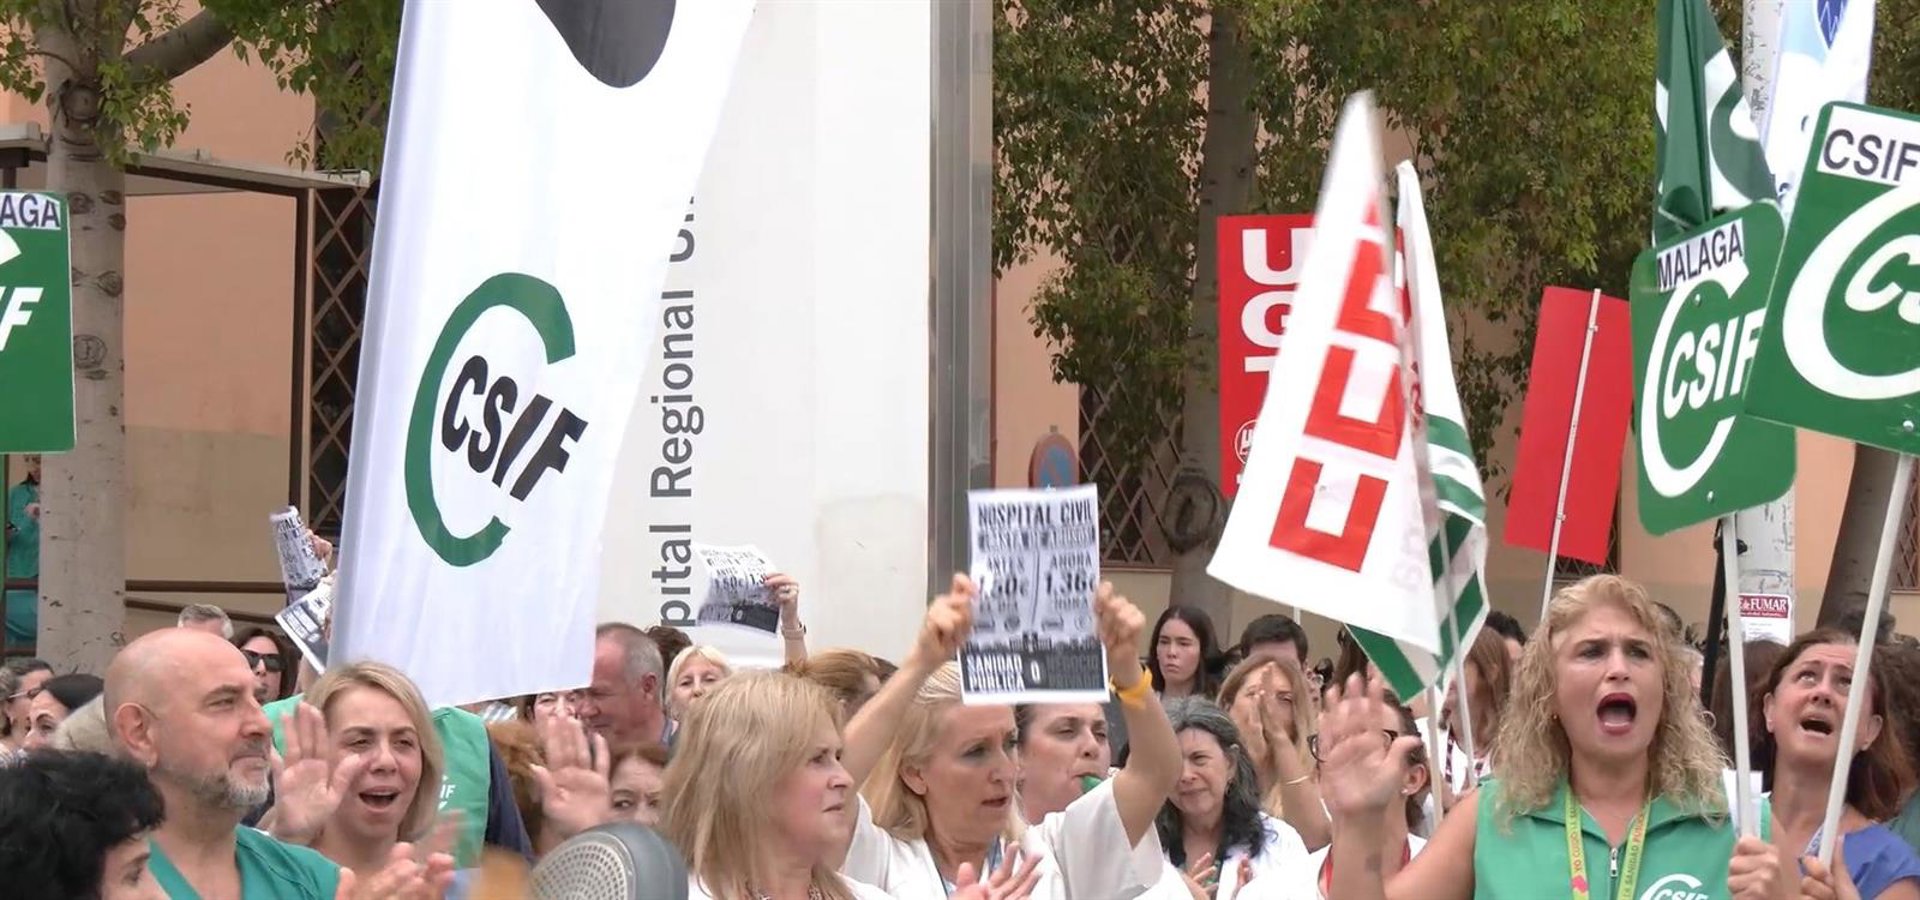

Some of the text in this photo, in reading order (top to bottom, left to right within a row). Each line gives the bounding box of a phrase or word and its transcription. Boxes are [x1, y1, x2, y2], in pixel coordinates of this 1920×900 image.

[1656, 222, 1744, 291] MALAGA
[1663, 306, 1767, 420] CSIF
[650, 290, 704, 497] Regional
[442, 355, 588, 502] CSIF
[978, 500, 1092, 527] HOSPITAL CIVIL
[1051, 551, 1092, 569] AHORA
[1750, 598, 1787, 613] FUMAR
[967, 653, 1023, 674] SANIDAD
